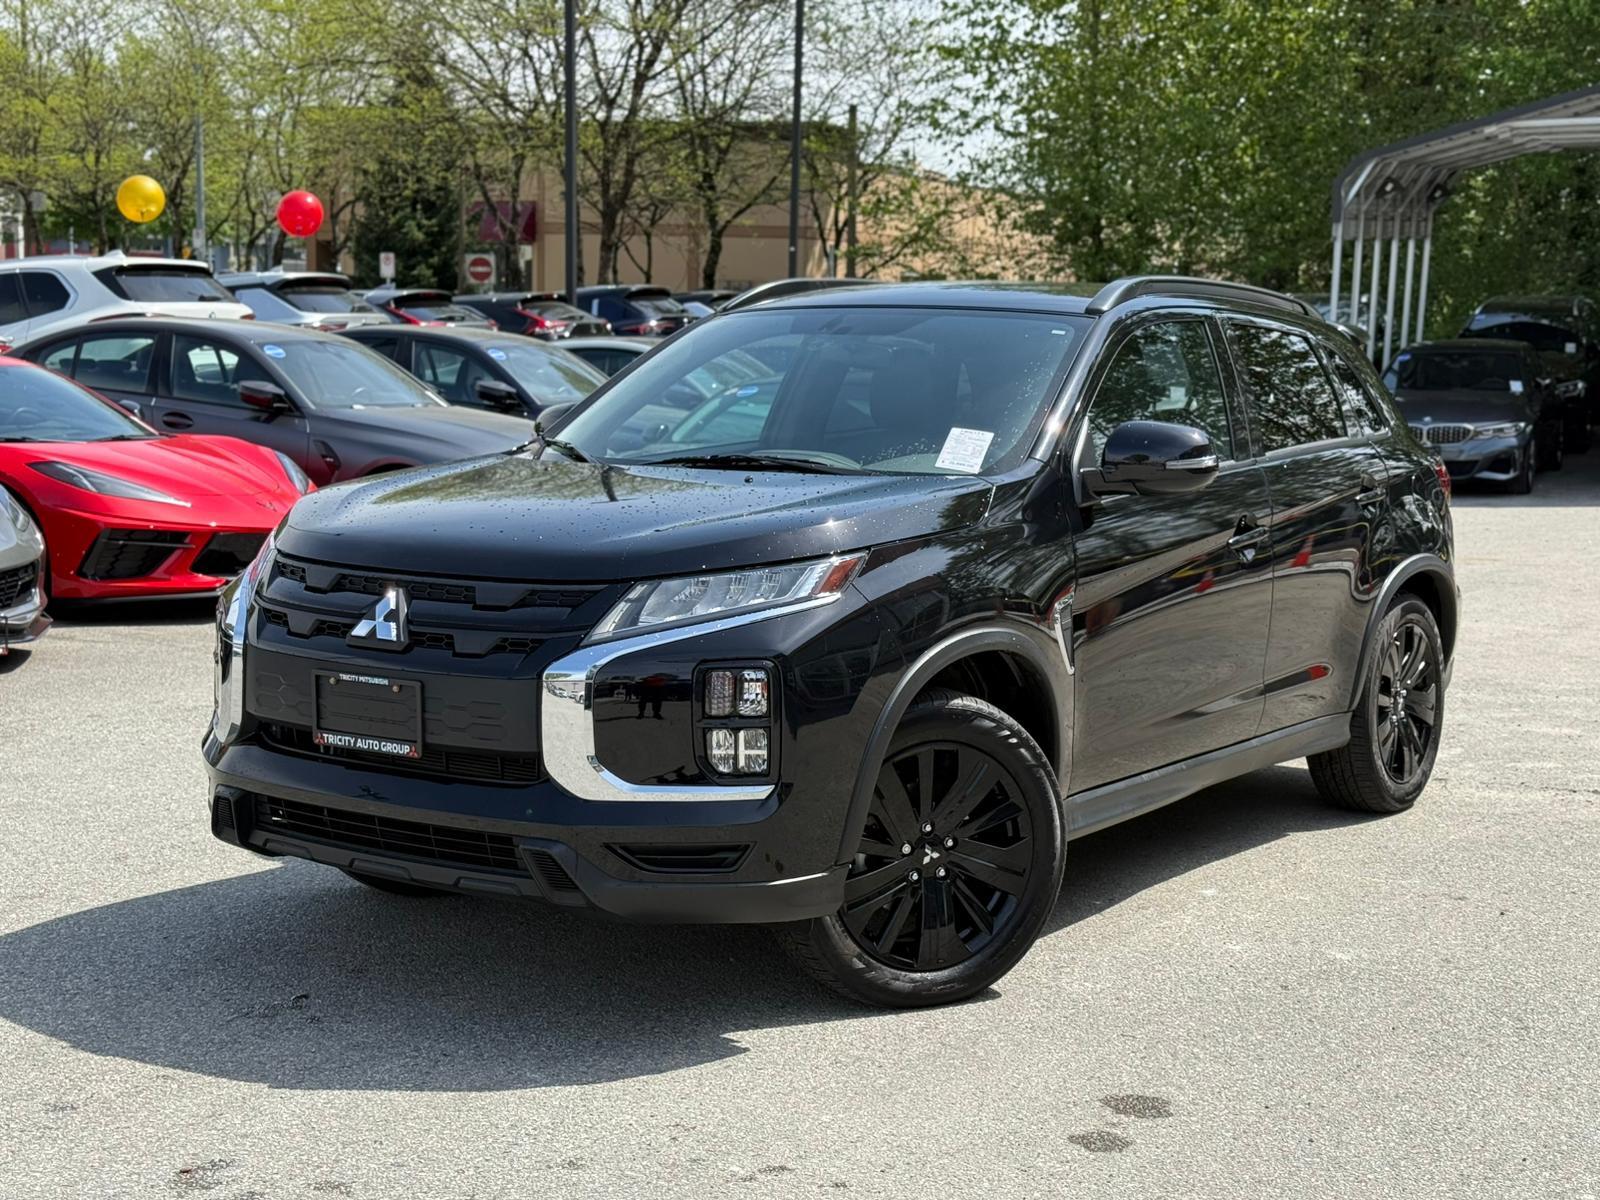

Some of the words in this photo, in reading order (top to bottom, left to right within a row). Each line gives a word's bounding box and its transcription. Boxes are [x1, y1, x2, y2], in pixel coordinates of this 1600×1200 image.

[339, 673, 358, 682] TRICITY
[322, 733, 355, 746] TRICITY
[356, 739, 380, 751] AUTO
[380, 742, 410, 754] GROUP
